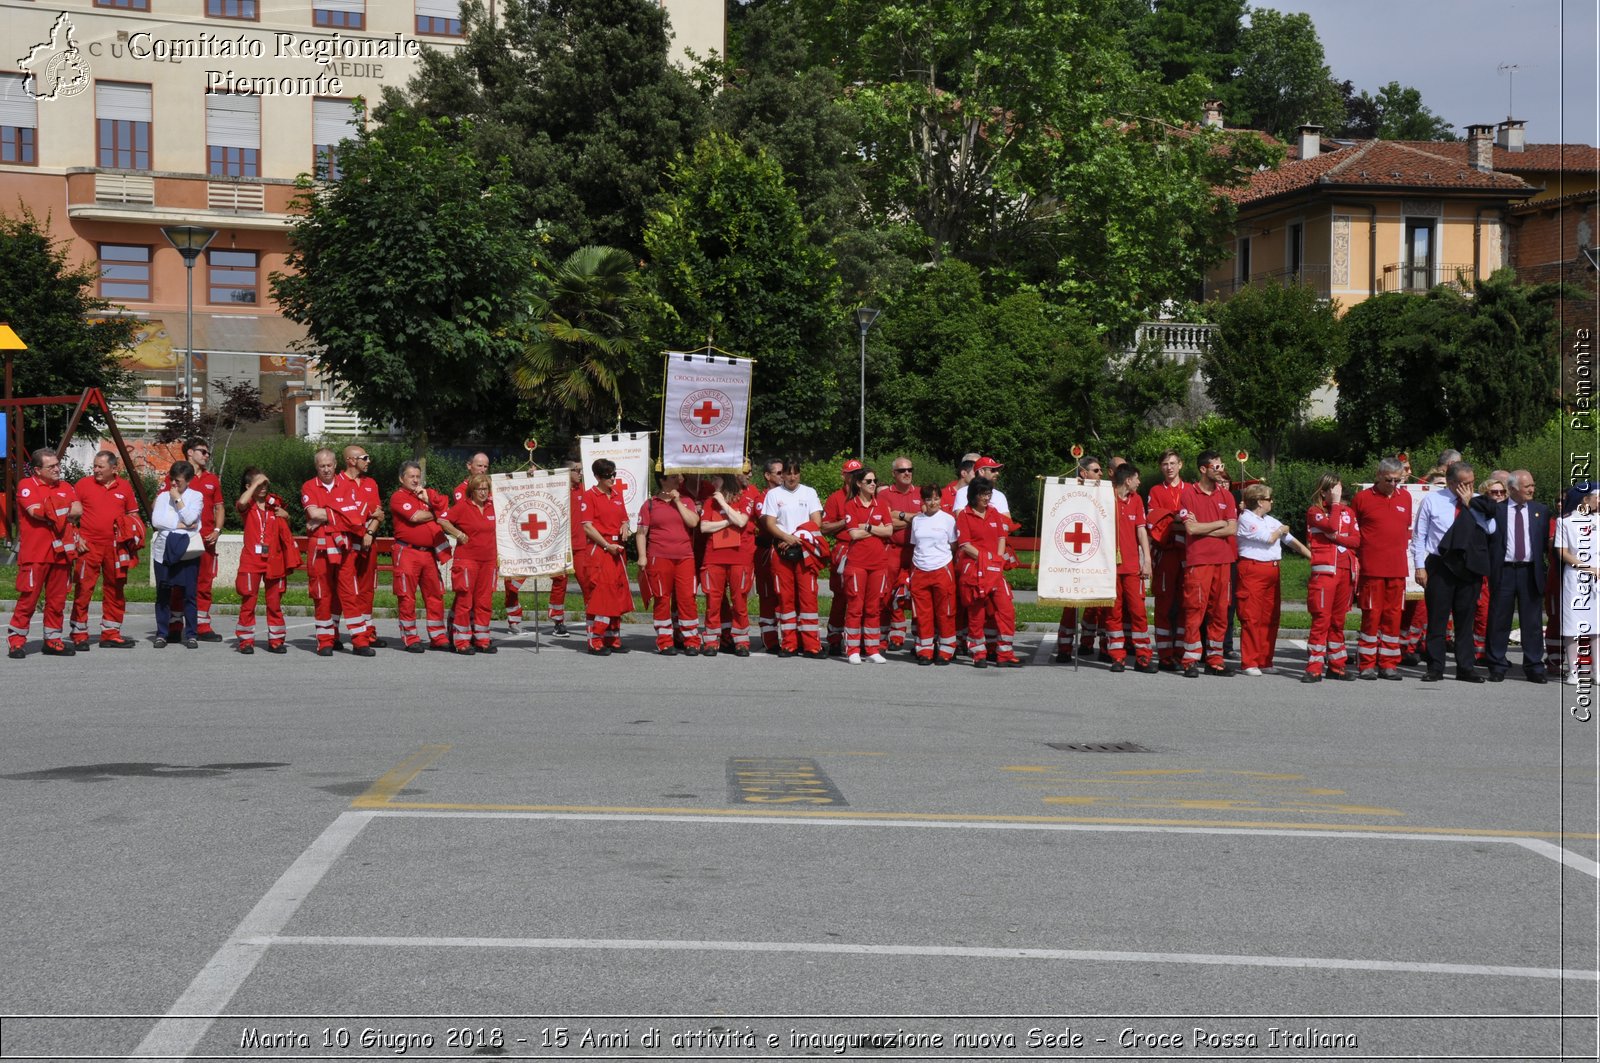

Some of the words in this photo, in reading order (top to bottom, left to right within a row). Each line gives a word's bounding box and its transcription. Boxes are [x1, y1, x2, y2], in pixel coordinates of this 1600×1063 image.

[322, 61, 386, 80] MEDIE
[716, 376, 744, 384] ITALIANA
[682, 444, 725, 454] MANTA
[498, 499, 516, 525] CROCE
[513, 490, 541, 503] ROSSA
[543, 491, 568, 519] ITALIANA
[1050, 496, 1067, 517] CROCE
[500, 558, 533, 566] GRUPPO
[1048, 566, 1081, 574] COMITATO
[1082, 566, 1108, 574] LOCALE
[1059, 586, 1095, 594] BUSCA
